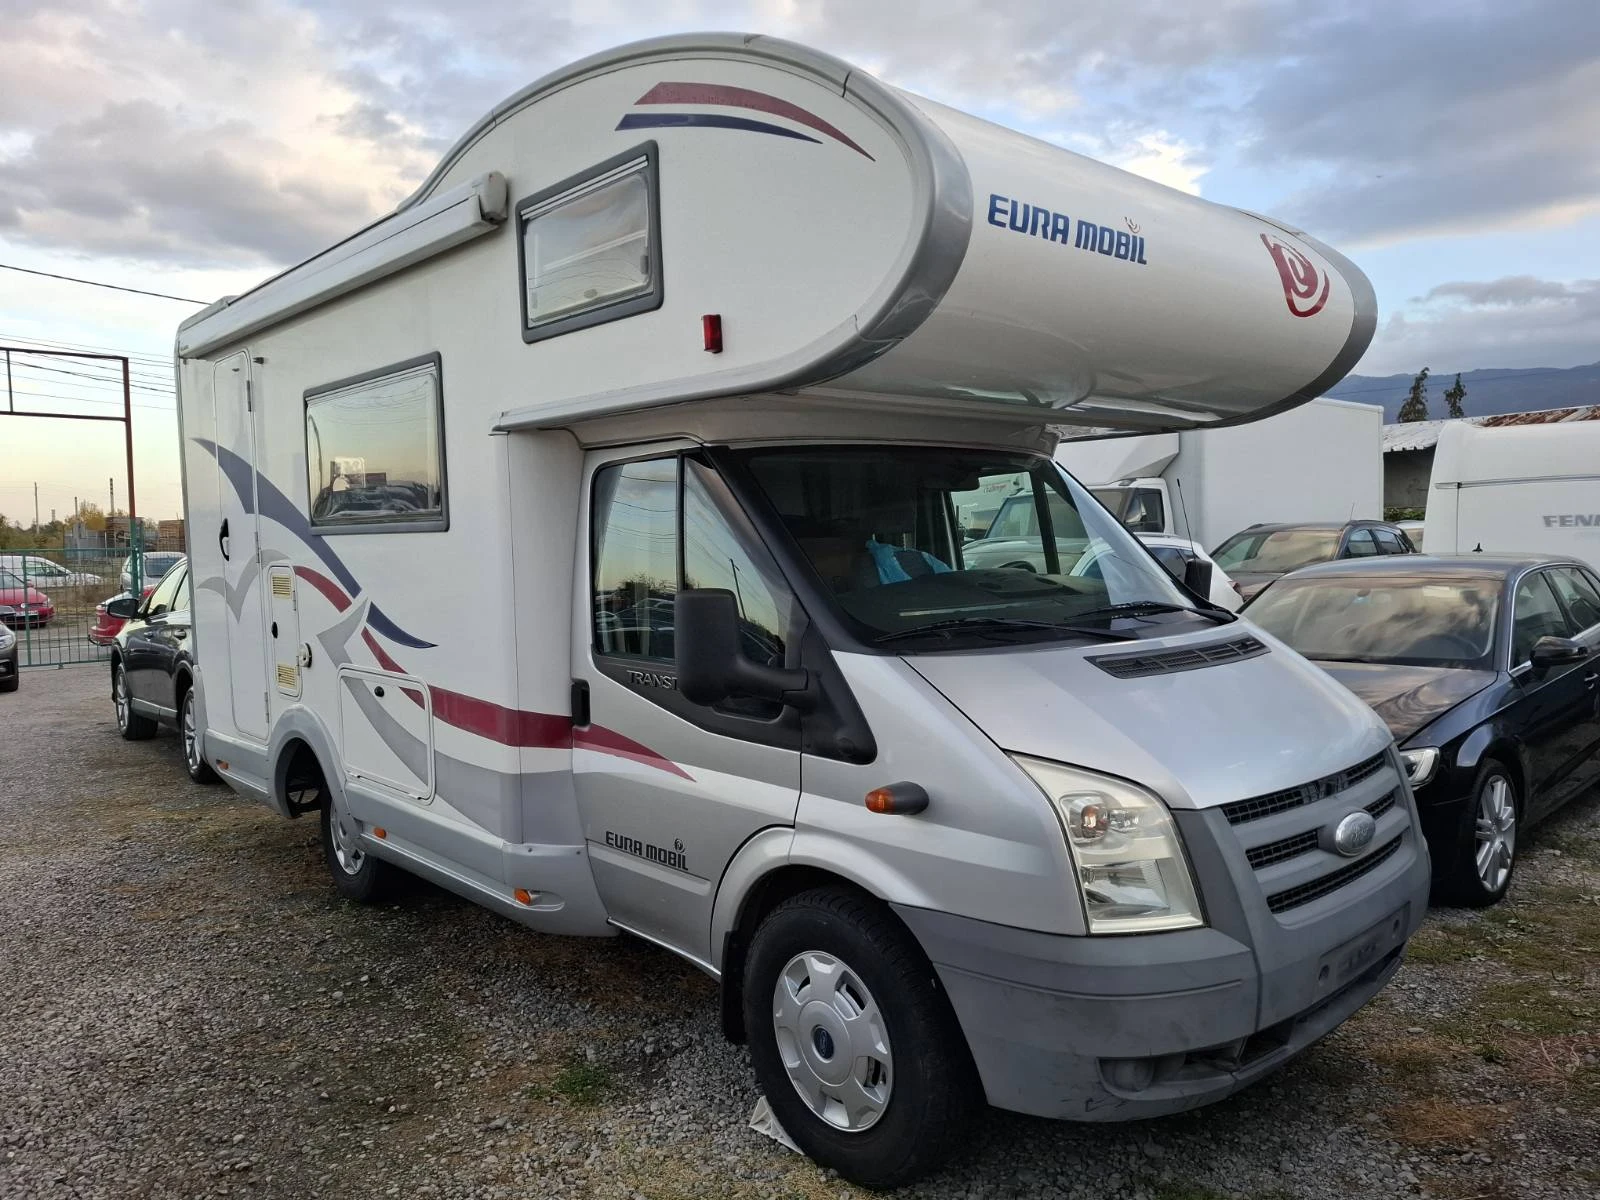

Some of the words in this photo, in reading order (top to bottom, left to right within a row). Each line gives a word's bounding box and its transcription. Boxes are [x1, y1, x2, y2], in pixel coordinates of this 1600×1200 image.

[988, 194, 1069, 245] EURA
[1074, 219, 1147, 265] MOBIL
[605, 830, 643, 856] EURA
[646, 843, 689, 871] MOBIL
